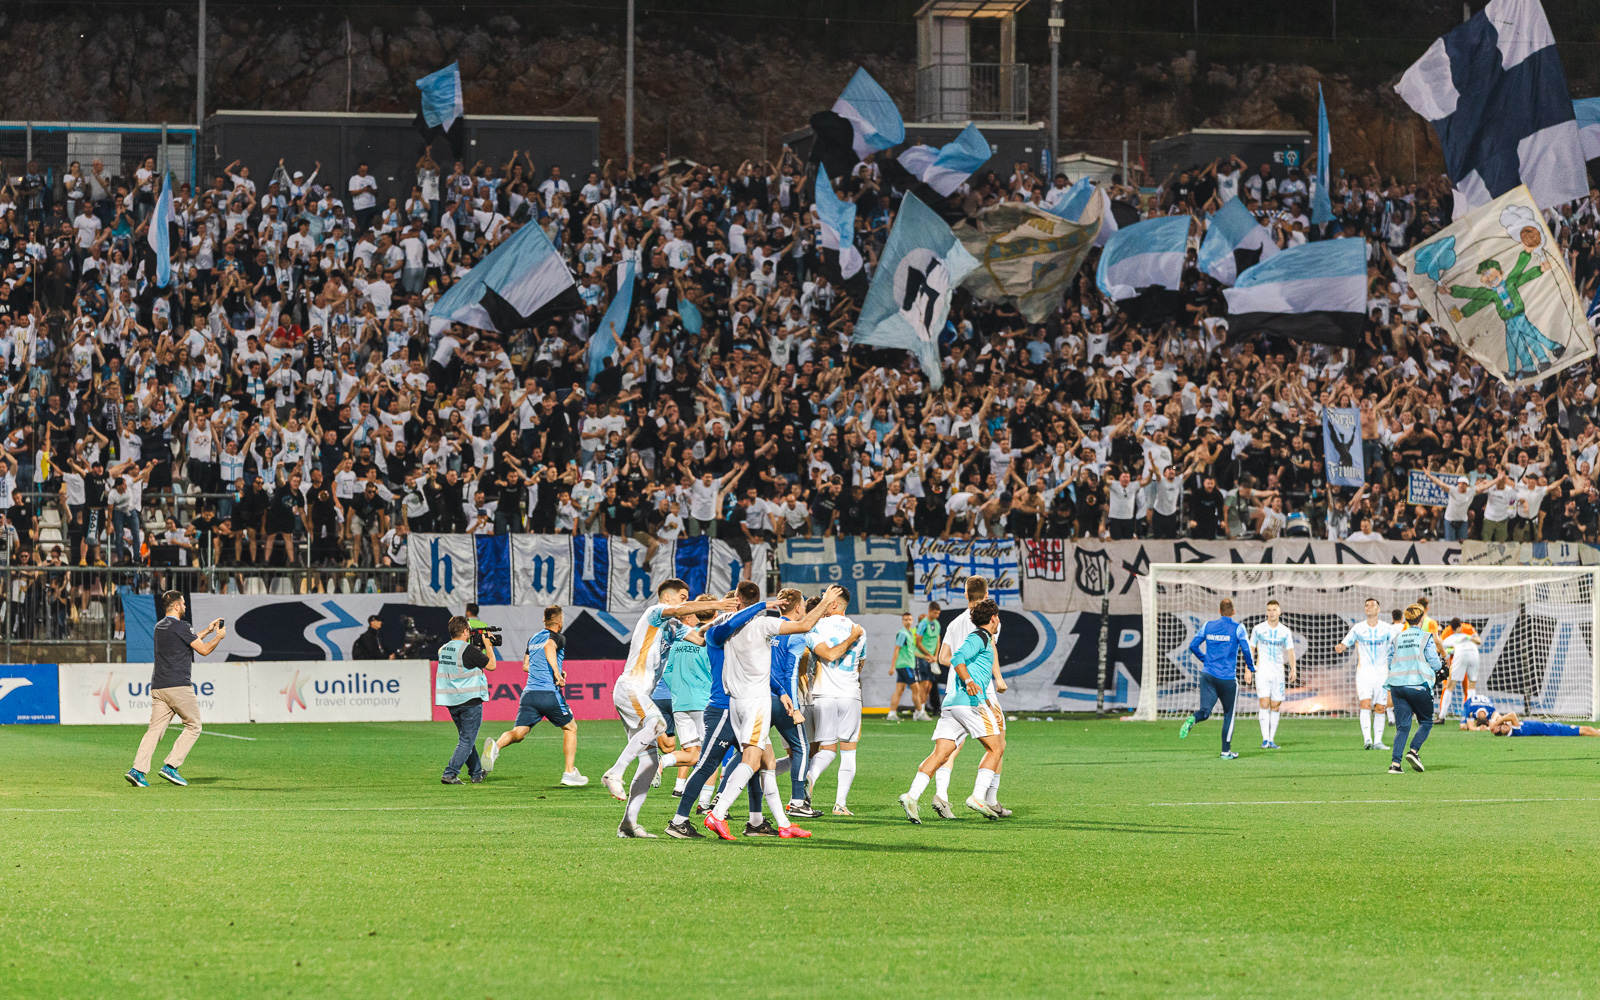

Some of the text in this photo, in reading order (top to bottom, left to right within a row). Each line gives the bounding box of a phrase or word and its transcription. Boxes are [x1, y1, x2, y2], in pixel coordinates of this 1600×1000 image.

[1411, 494, 1451, 507] CHAMPIO
[917, 538, 976, 556] United
[971, 540, 1014, 557] colors
[813, 562, 886, 582] 1987
[920, 562, 1016, 595] of Arda
[315, 673, 400, 694] uniline
[488, 683, 607, 701] AVET
[315, 697, 400, 707] travel company
